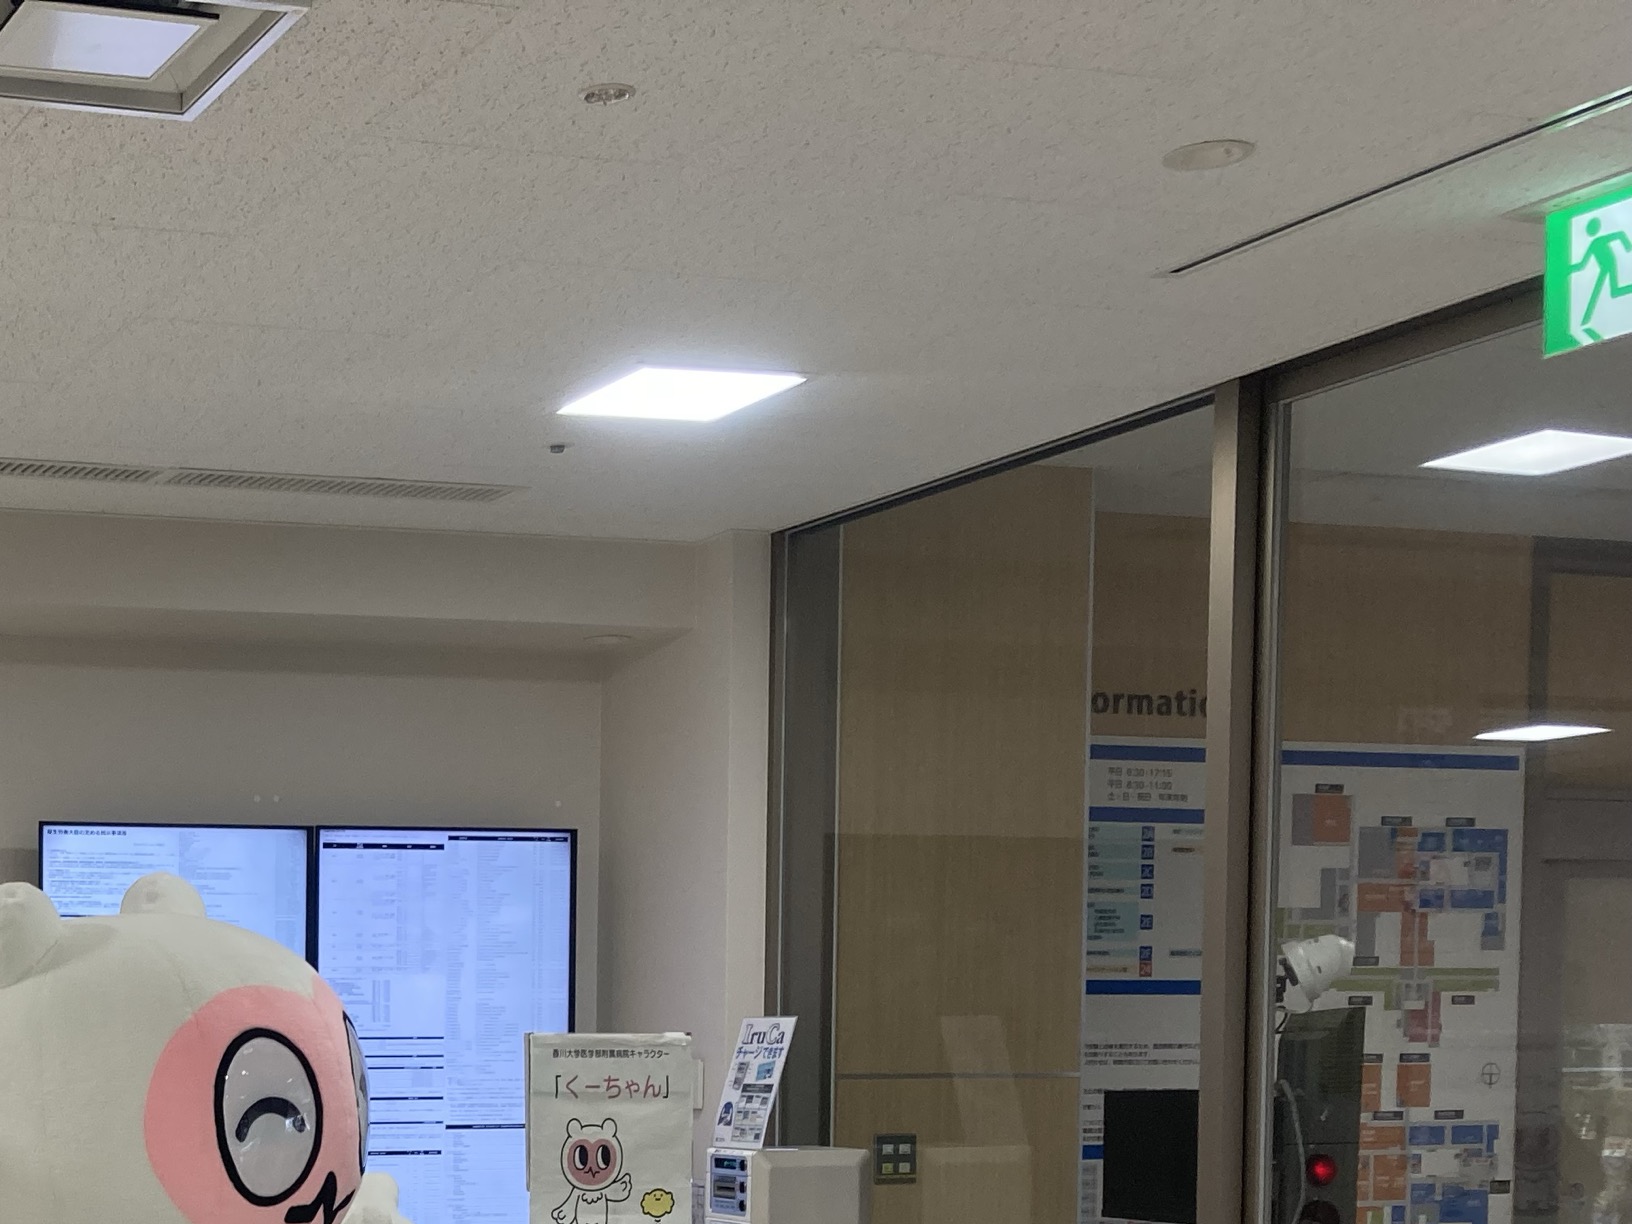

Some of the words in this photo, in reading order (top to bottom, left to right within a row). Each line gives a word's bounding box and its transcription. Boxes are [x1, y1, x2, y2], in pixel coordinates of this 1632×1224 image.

[741, 1022, 785, 1045] IruCa
[735, 1046, 784, 1060] チャージできます
[554, 1074, 669, 1099] 「くーちゃん」
